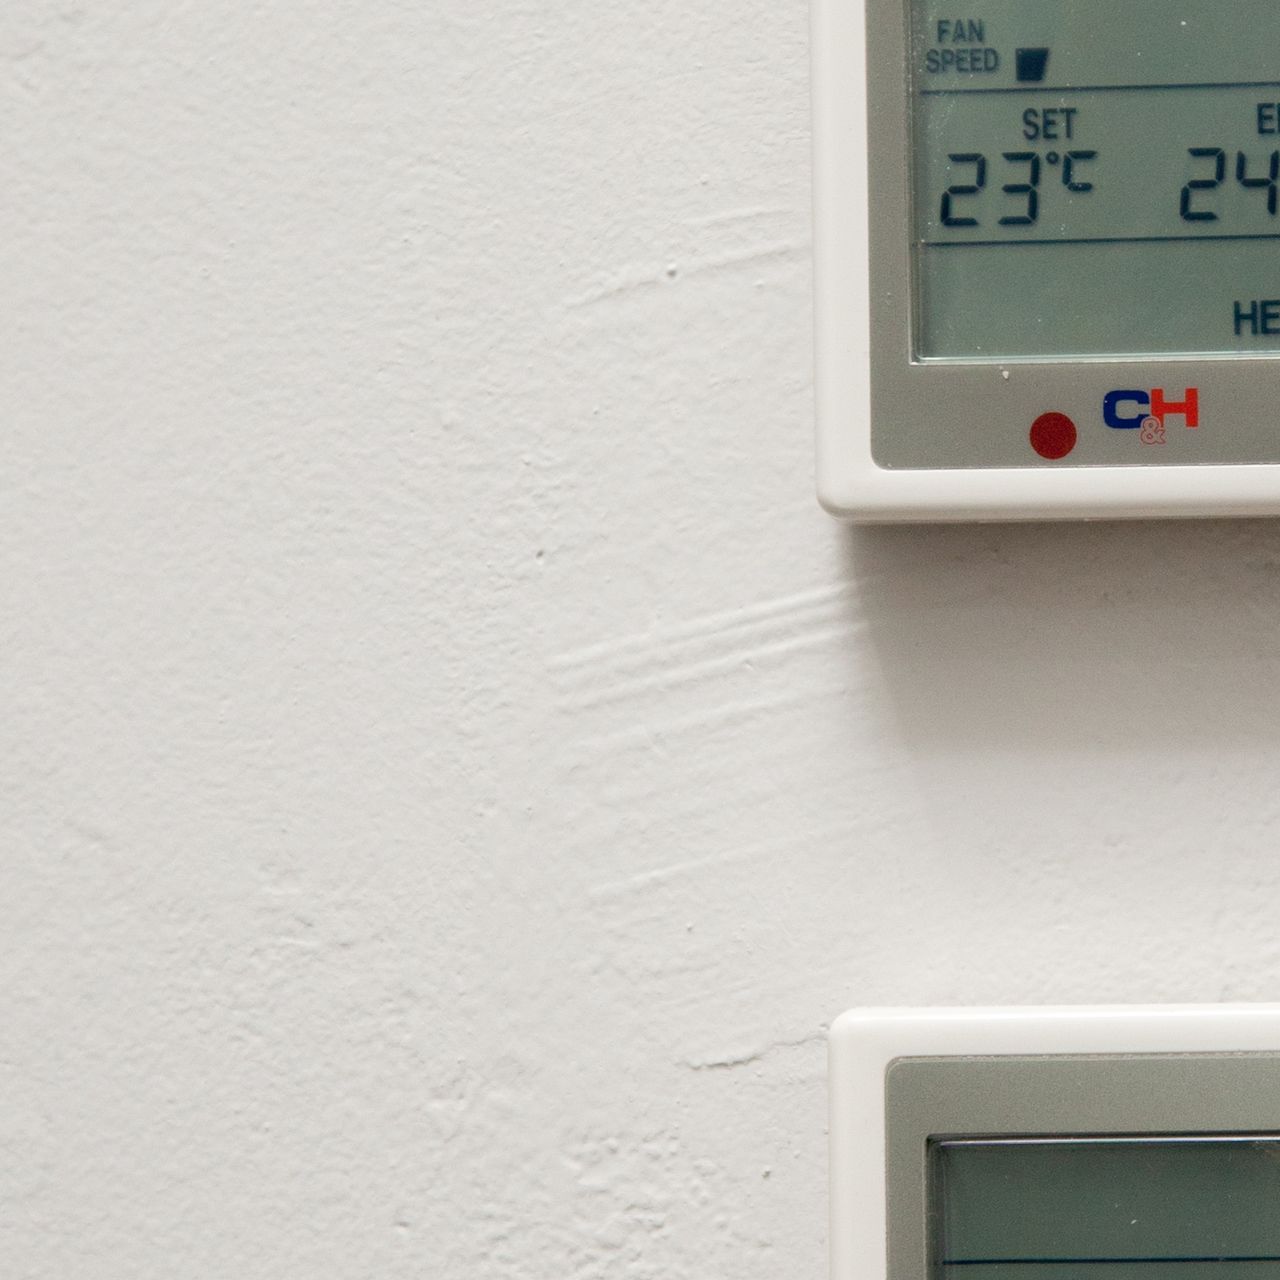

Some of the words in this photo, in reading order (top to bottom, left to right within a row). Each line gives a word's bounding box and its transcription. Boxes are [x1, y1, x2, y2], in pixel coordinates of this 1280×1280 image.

[936, 19, 984, 43] FAN
[926, 49, 999, 74] SPEED
[1022, 108, 1078, 139] SET
